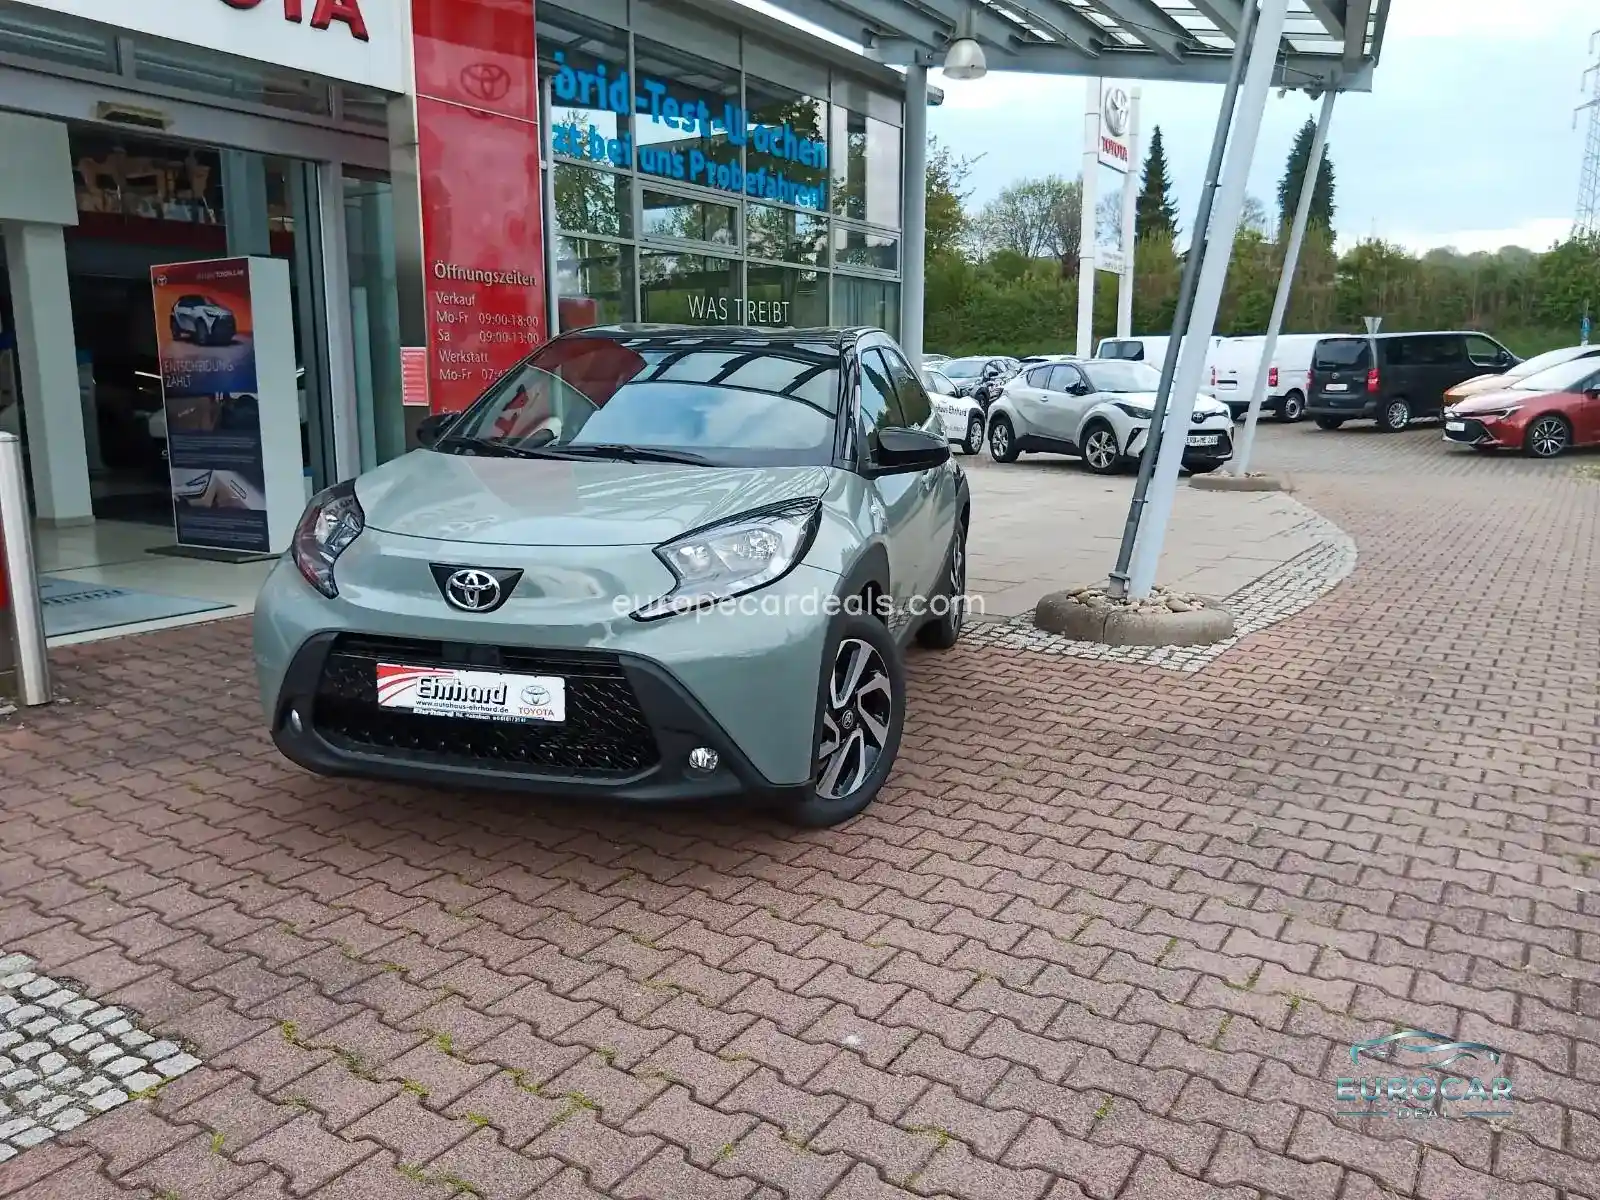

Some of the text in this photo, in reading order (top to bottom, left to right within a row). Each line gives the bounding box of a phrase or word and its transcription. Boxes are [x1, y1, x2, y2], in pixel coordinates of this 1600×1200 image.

[588, 124, 633, 168] bei
[639, 143, 684, 180] uns
[1101, 135, 1128, 162] TOYOTA
[434, 260, 537, 287] Öffnungszeiten
[435, 291, 475, 306] Verkauf
[687, 294, 728, 320] WAS
[436, 311, 539, 327] Mo-Fr 09:00-18:00
[438, 328, 539, 344] Sa 09:00-13:00
[439, 348, 489, 363] Werkstatt
[439, 368, 472, 381] Mo-Fr
[416, 676, 508, 705] Ehrhard
[415, 700, 509, 714] www.autohaus-ehrhard.de
[518, 706, 556, 717] TOYOTA
